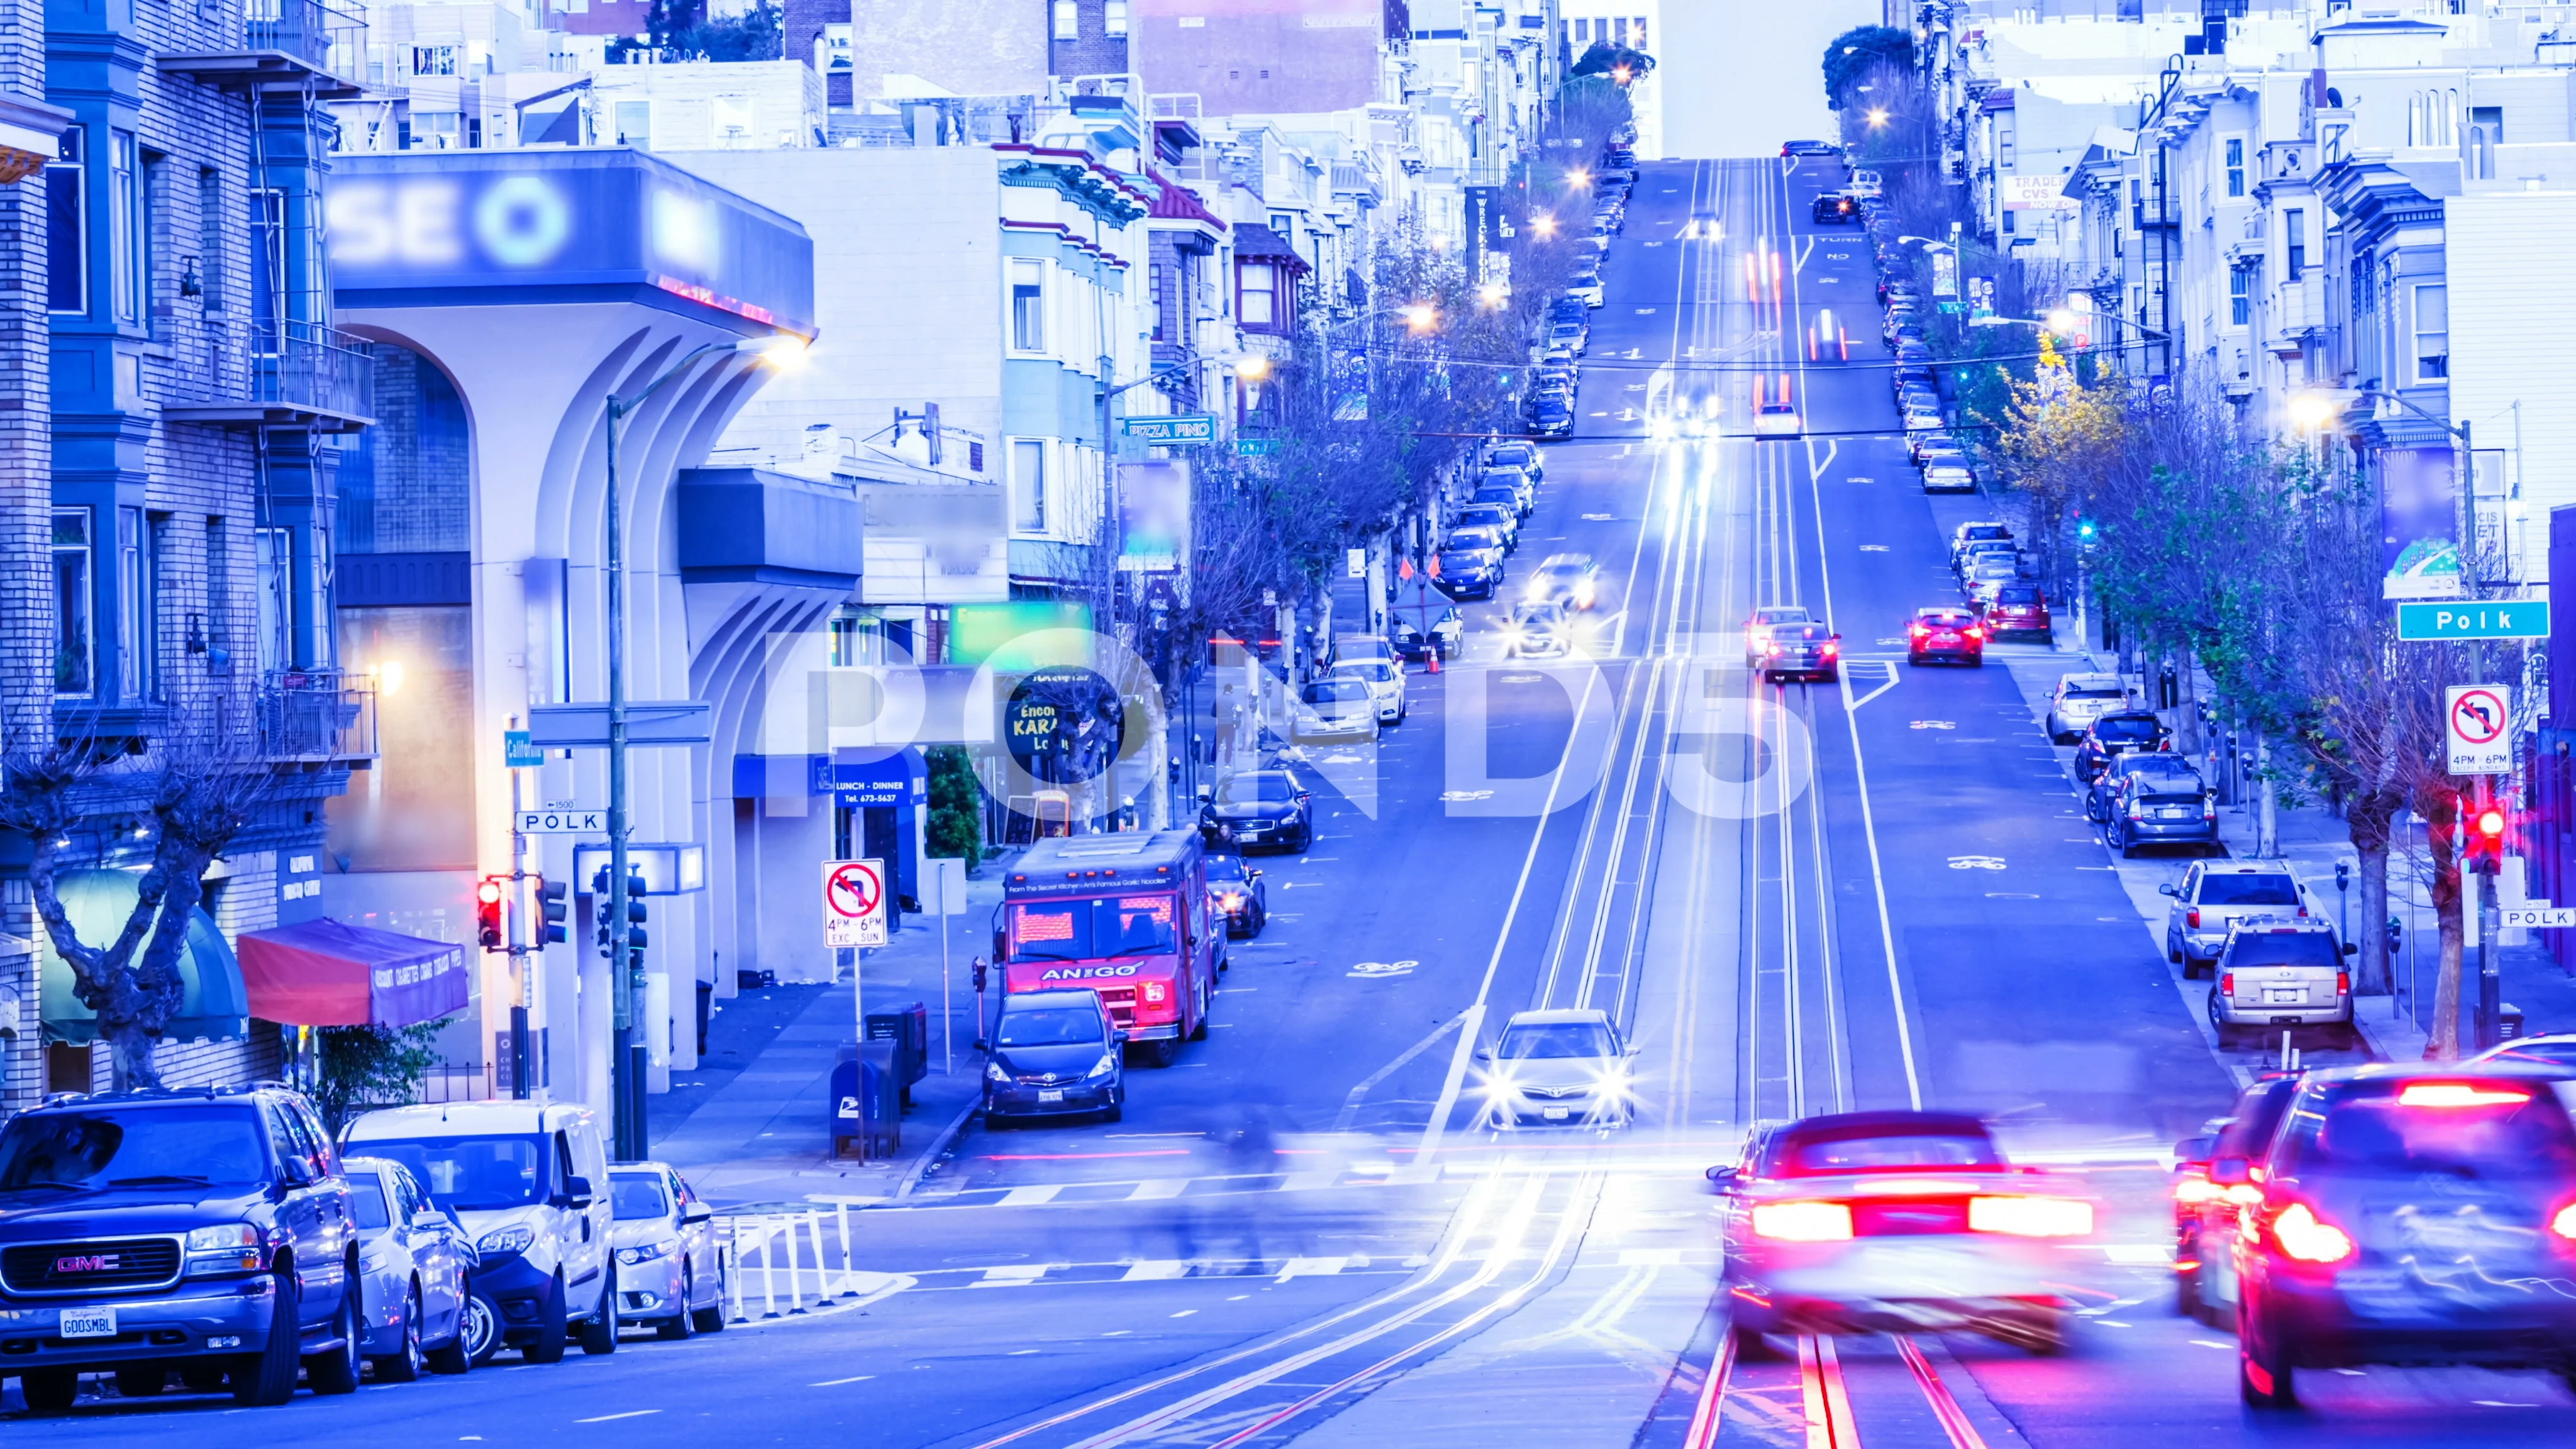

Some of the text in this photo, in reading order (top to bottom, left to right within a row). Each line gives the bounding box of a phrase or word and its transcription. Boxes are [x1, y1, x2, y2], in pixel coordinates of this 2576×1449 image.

[2030, 201, 2058, 209] NOW
[1129, 423, 1211, 438] PIZZA PINO
[2436, 610, 2511, 630] Polk
[2453, 755, 2475, 764] 4PM
[2485, 755, 2507, 764] 6PM
[836, 782, 865, 791] LUNCH
[872, 782, 904, 790] DINNER
[845, 794, 896, 802] Tel. 673-5637
[526, 814, 597, 829] POLK
[828, 918, 850, 931] 4PM
[860, 917, 882, 931] 6PM
[2509, 912, 2567, 924] POLK
[832, 933, 879, 943] EXC SUN
[58, 1255, 119, 1272] GMC
